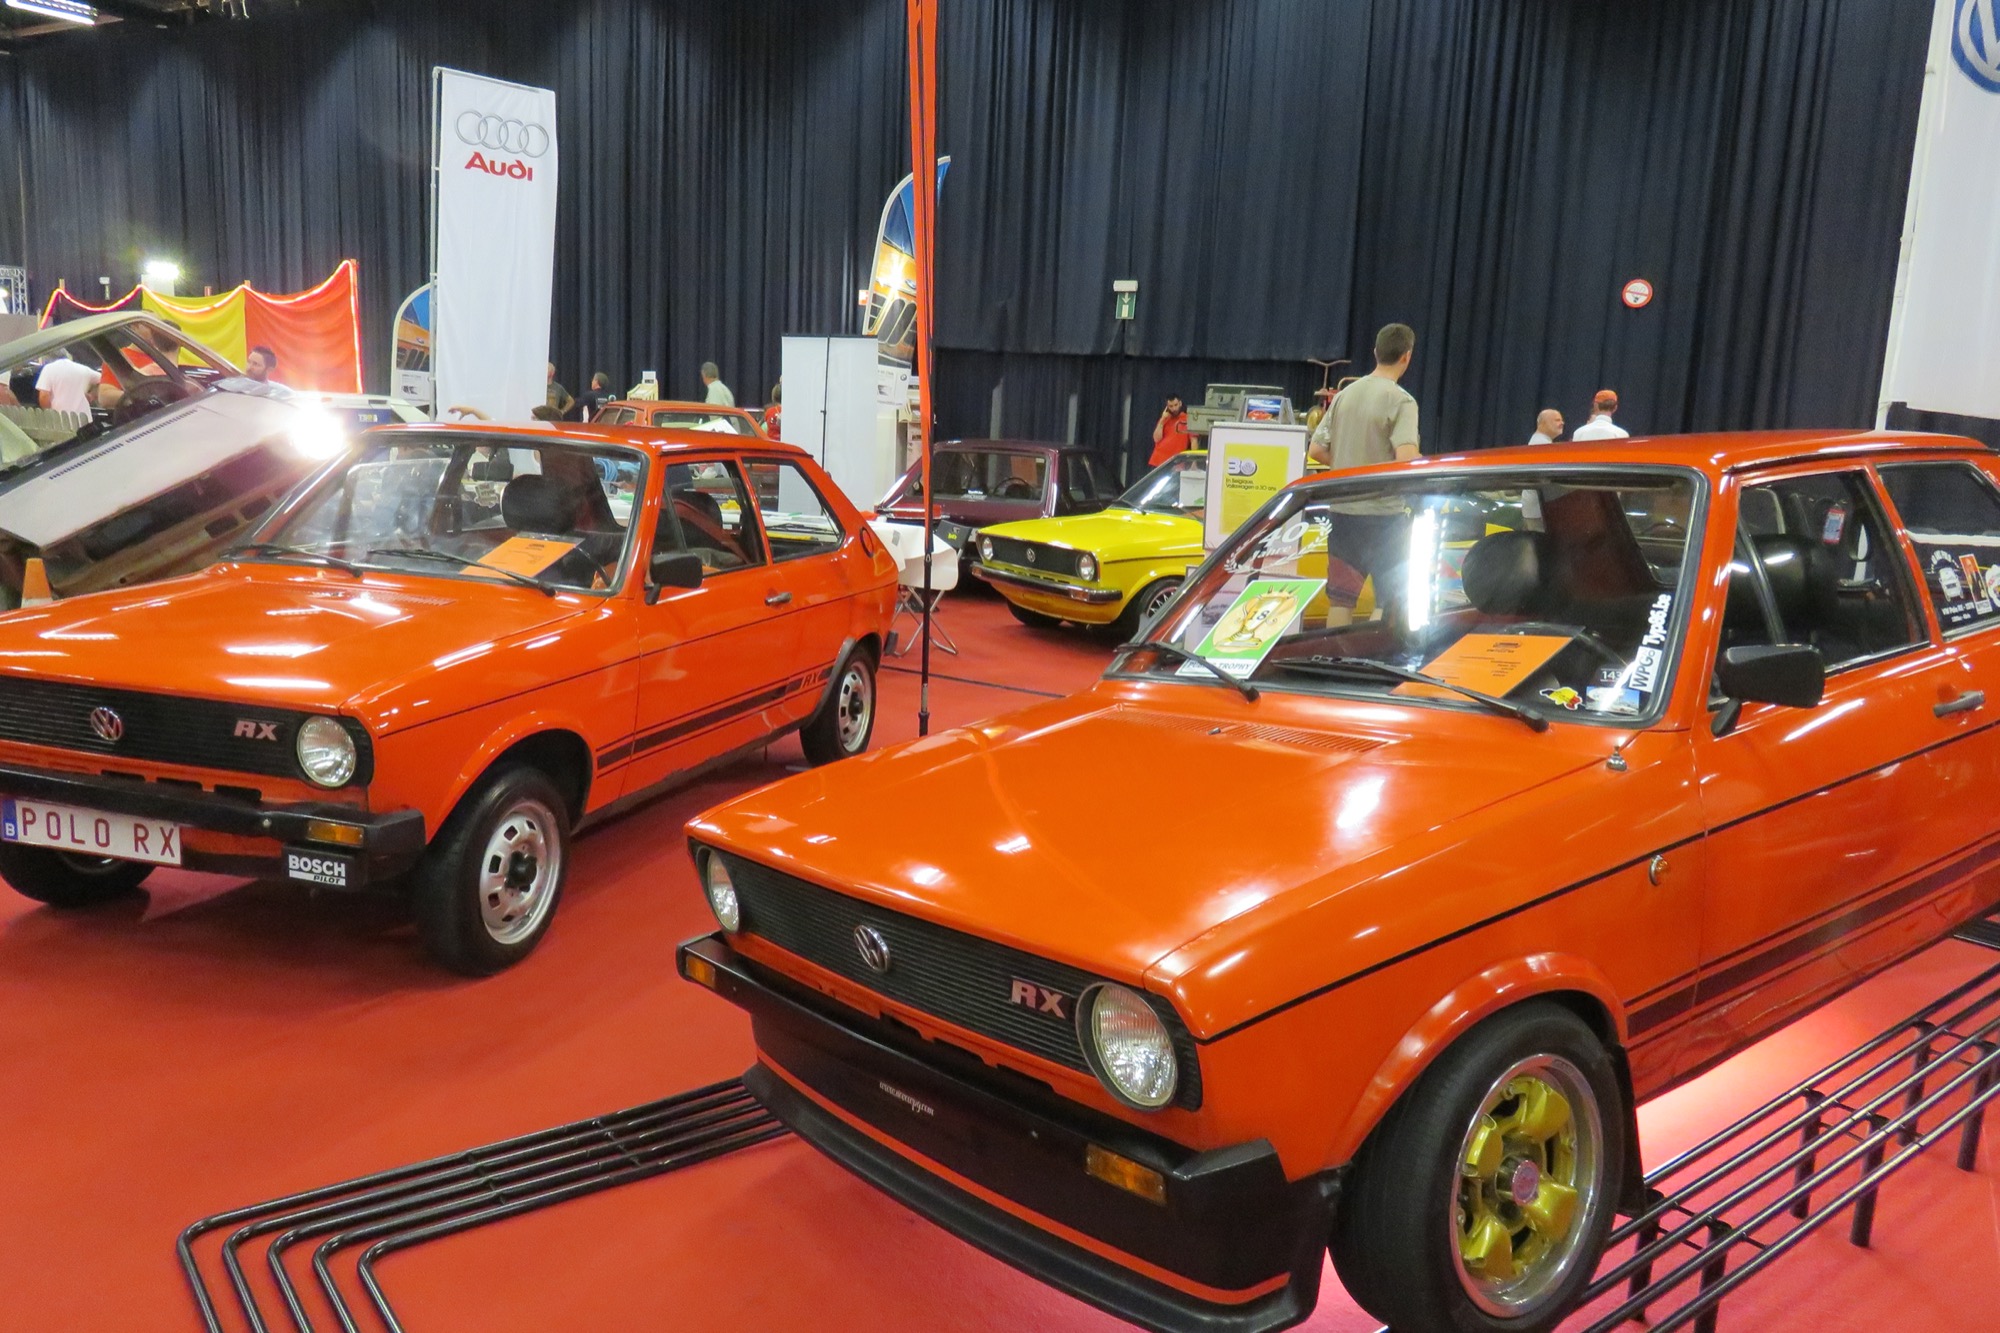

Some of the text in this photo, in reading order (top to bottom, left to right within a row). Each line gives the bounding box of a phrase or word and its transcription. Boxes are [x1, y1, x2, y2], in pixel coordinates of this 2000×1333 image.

[464, 151, 533, 181] Audi
[233, 719, 278, 741] RX
[22, 806, 111, 848] POLO
[133, 823, 175, 858] RX
[288, 854, 346, 877] BOSCH
[313, 875, 341, 884] PILOT
[1012, 979, 1066, 1019] RX
